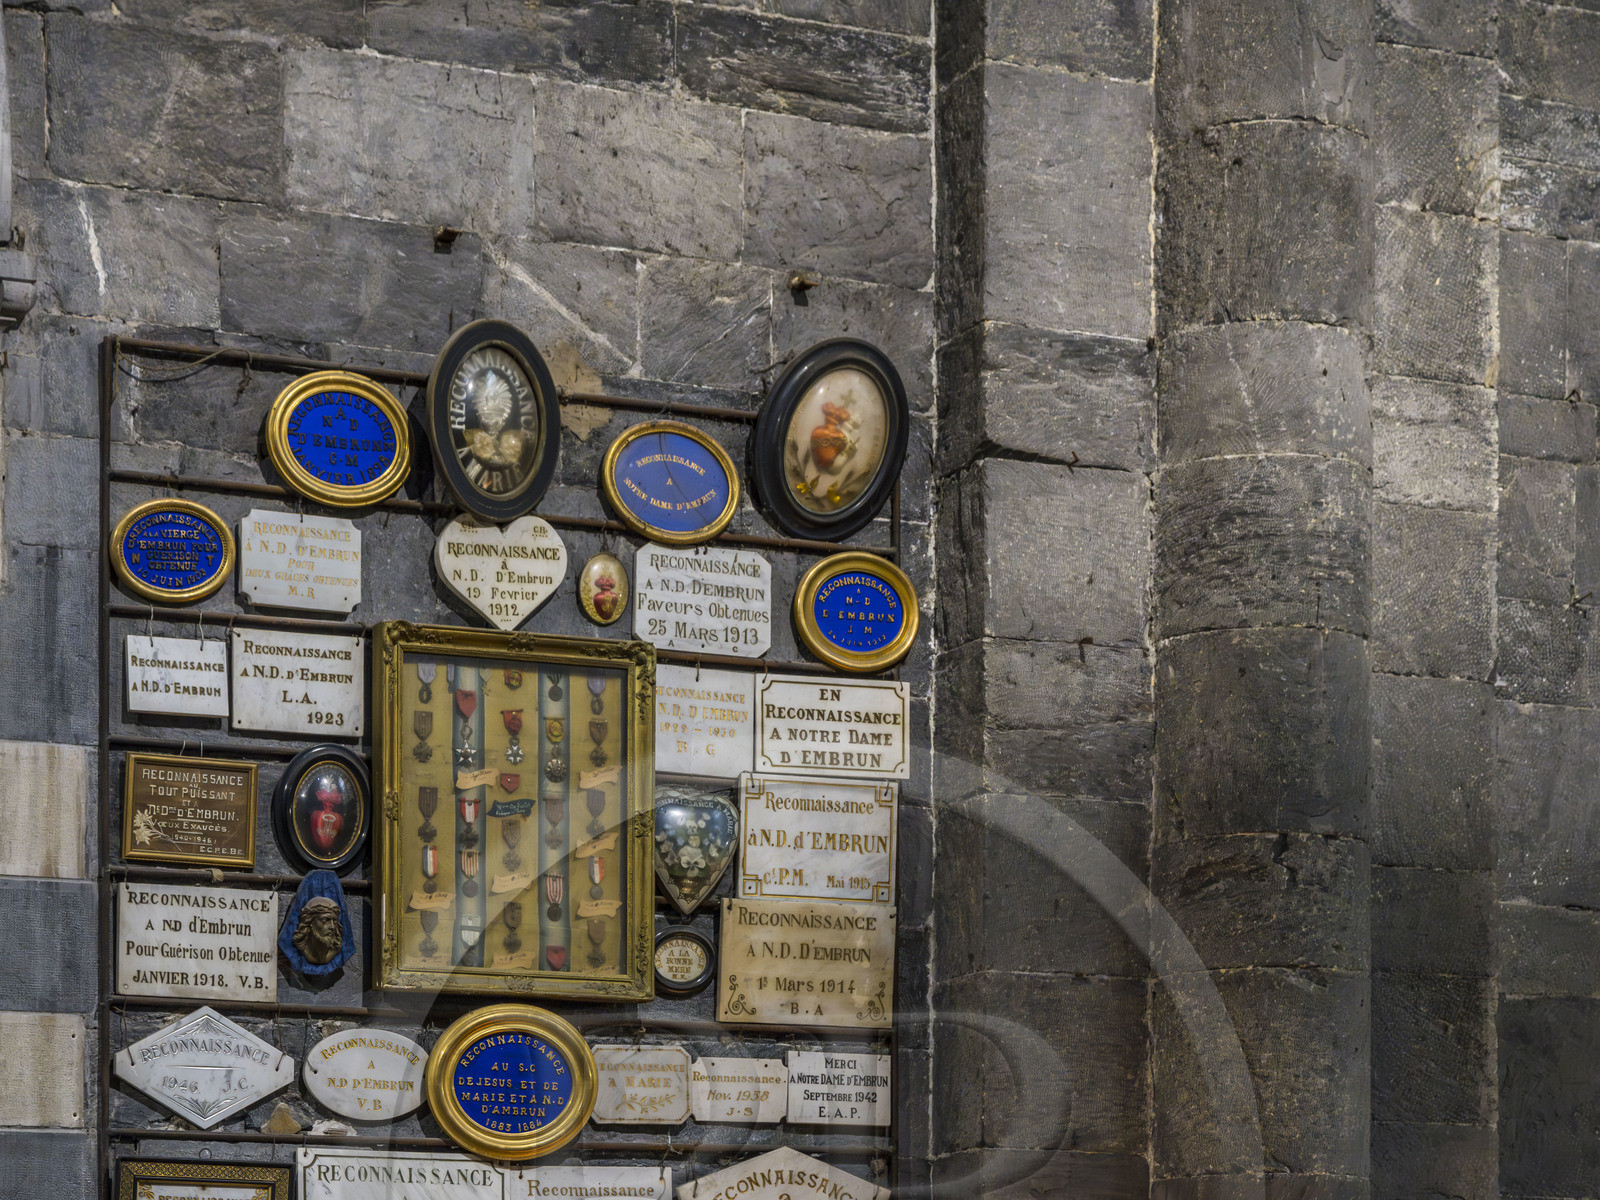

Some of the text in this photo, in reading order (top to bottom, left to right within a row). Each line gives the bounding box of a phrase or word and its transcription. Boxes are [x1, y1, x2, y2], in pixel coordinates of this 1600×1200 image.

[129, 514, 217, 543] RECONNAISSANCE
[160, 530, 200, 540] VIERGE
[254, 522, 351, 542] RECONNAISSANCE
[192, 542, 218, 552] POUR
[298, 546, 360, 562] D'EMBRUN
[447, 542, 560, 561] RECONNAISSANCE
[245, 568, 270, 578] DEUX
[288, 558, 314, 572] POUR
[650, 554, 761, 578] RECONNAISSANCE
[818, 576, 896, 608] RECONNAISSANCE
[708, 602, 770, 624] Obtenues
[723, 626, 759, 646] 1913
[244, 640, 352, 660] RECONNAISSANCE
[130, 655, 224, 672] RECONNAISSANCE
[286, 668, 352, 684] D'EMBRUN
[164, 682, 221, 697] D'EMBRUN
[819, 688, 841, 702] EN
[306, 712, 344, 726] 1923
[765, 704, 900, 726] RECONNAISSANCE
[788, 728, 892, 746] NOTRE DAME
[780, 750, 882, 768] D'EMBRUN
[142, 768, 244, 786] RECONNAISSANCE
[182, 787, 236, 802] PUISSANT
[765, 791, 874, 816] Reconnaissance
[794, 830, 888, 855] d'EMBRUN
[826, 875, 846, 889] Mai
[128, 891, 270, 912] RECONNAISSANCE
[189, 916, 252, 936] d'Embrun
[738, 906, 877, 930] RECONNAISSANCE
[126, 940, 270, 963] Pour Guérison Obtenue
[800, 940, 871, 963] D'EMBRUN
[133, 970, 190, 986] JANVIER
[776, 977, 814, 992] Mars
[139, 1038, 270, 1066] RECONNAISSANCE
[320, 1038, 420, 1066] RECONNAISSANCE
[460, 1034, 565, 1076] RECONNAISSANCE
[824, 1058, 857, 1070] MERCI
[352, 1078, 414, 1092] D'EMBRUN
[476, 1078, 512, 1088] JESUS
[625, 1076, 672, 1088] MARIE
[796, 1072, 819, 1084] NOTRE
[461, 1092, 505, 1102] MARIE
[736, 1090, 770, 1102] 1938
[804, 1090, 852, 1102] SEPTEMBRE
[481, 1104, 546, 1117] D'AMBRUN
[486, 1118, 512, 1131] 1883
[317, 1164, 494, 1187] RECONNAISSANCE
[527, 1180, 655, 1196] Reconnaissance
